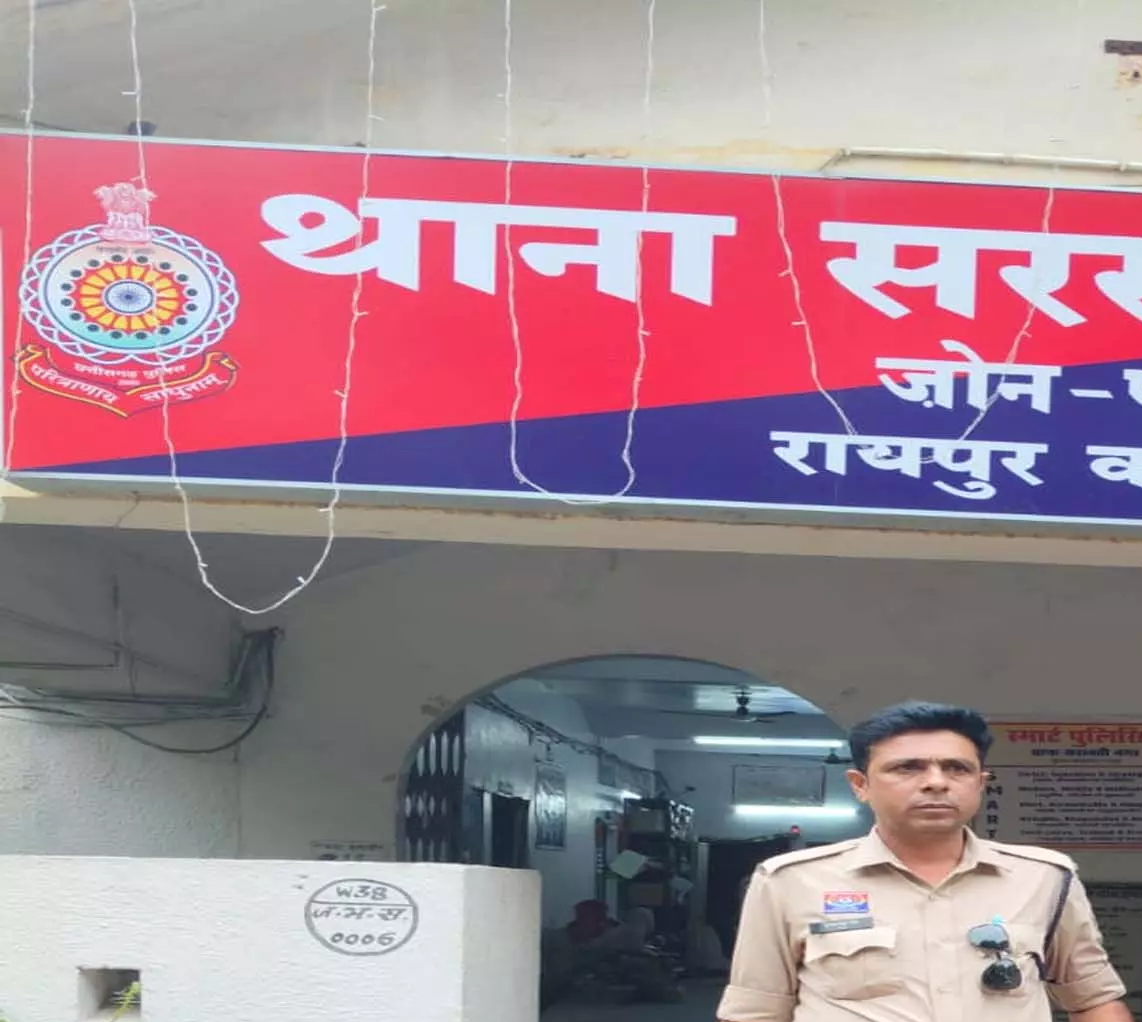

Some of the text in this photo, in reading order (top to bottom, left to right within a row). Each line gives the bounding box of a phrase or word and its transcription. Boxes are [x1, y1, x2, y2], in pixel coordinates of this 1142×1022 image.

[259, 194, 736, 306] थाना
[770, 430, 1048, 500] रायपुर
[335, 885, 388, 901] W38
[330, 932, 397, 946] 0006
